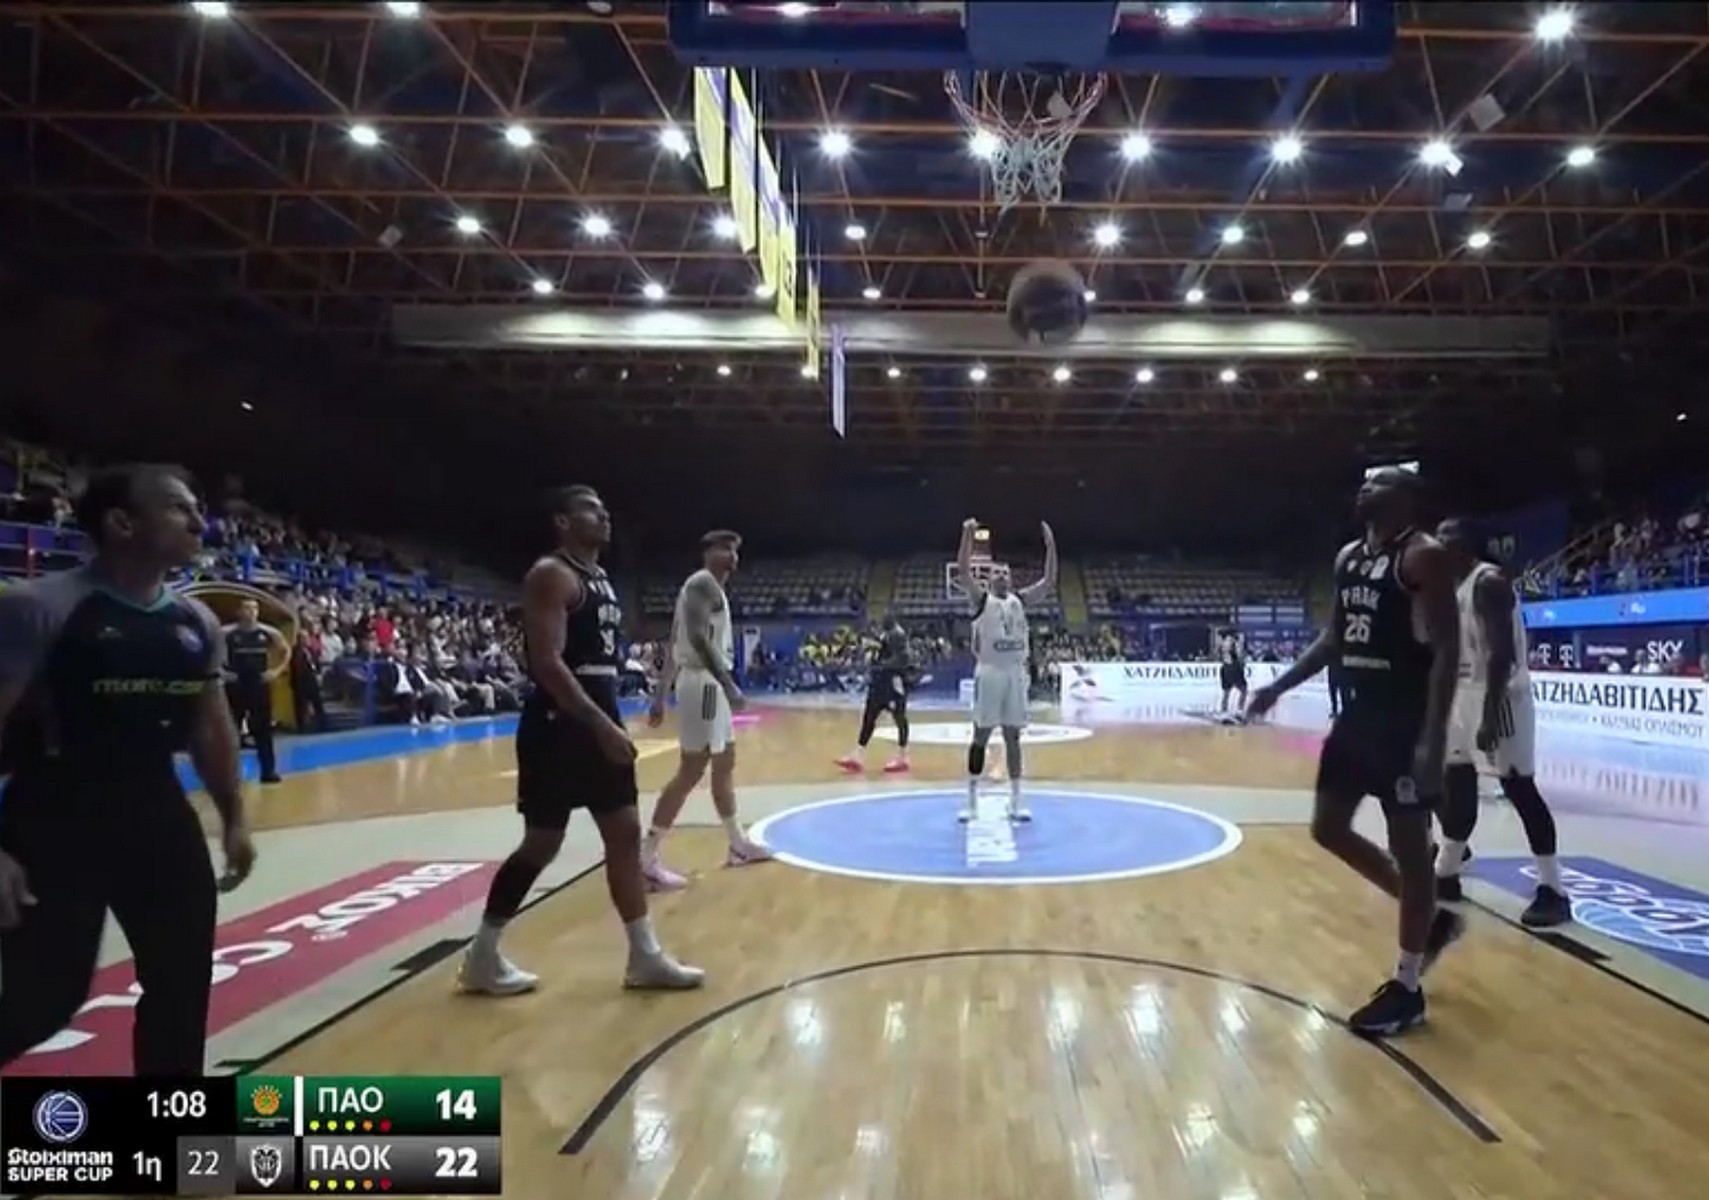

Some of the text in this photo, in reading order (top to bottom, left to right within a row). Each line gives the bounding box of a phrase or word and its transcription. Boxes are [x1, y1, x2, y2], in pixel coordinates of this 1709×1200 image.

[1344, 612, 1371, 643] 26
[1647, 641, 1683, 663] SKY
[1532, 680, 1704, 716] ΑΤΖΗΔΑΒΙΤΙΔΗΣ
